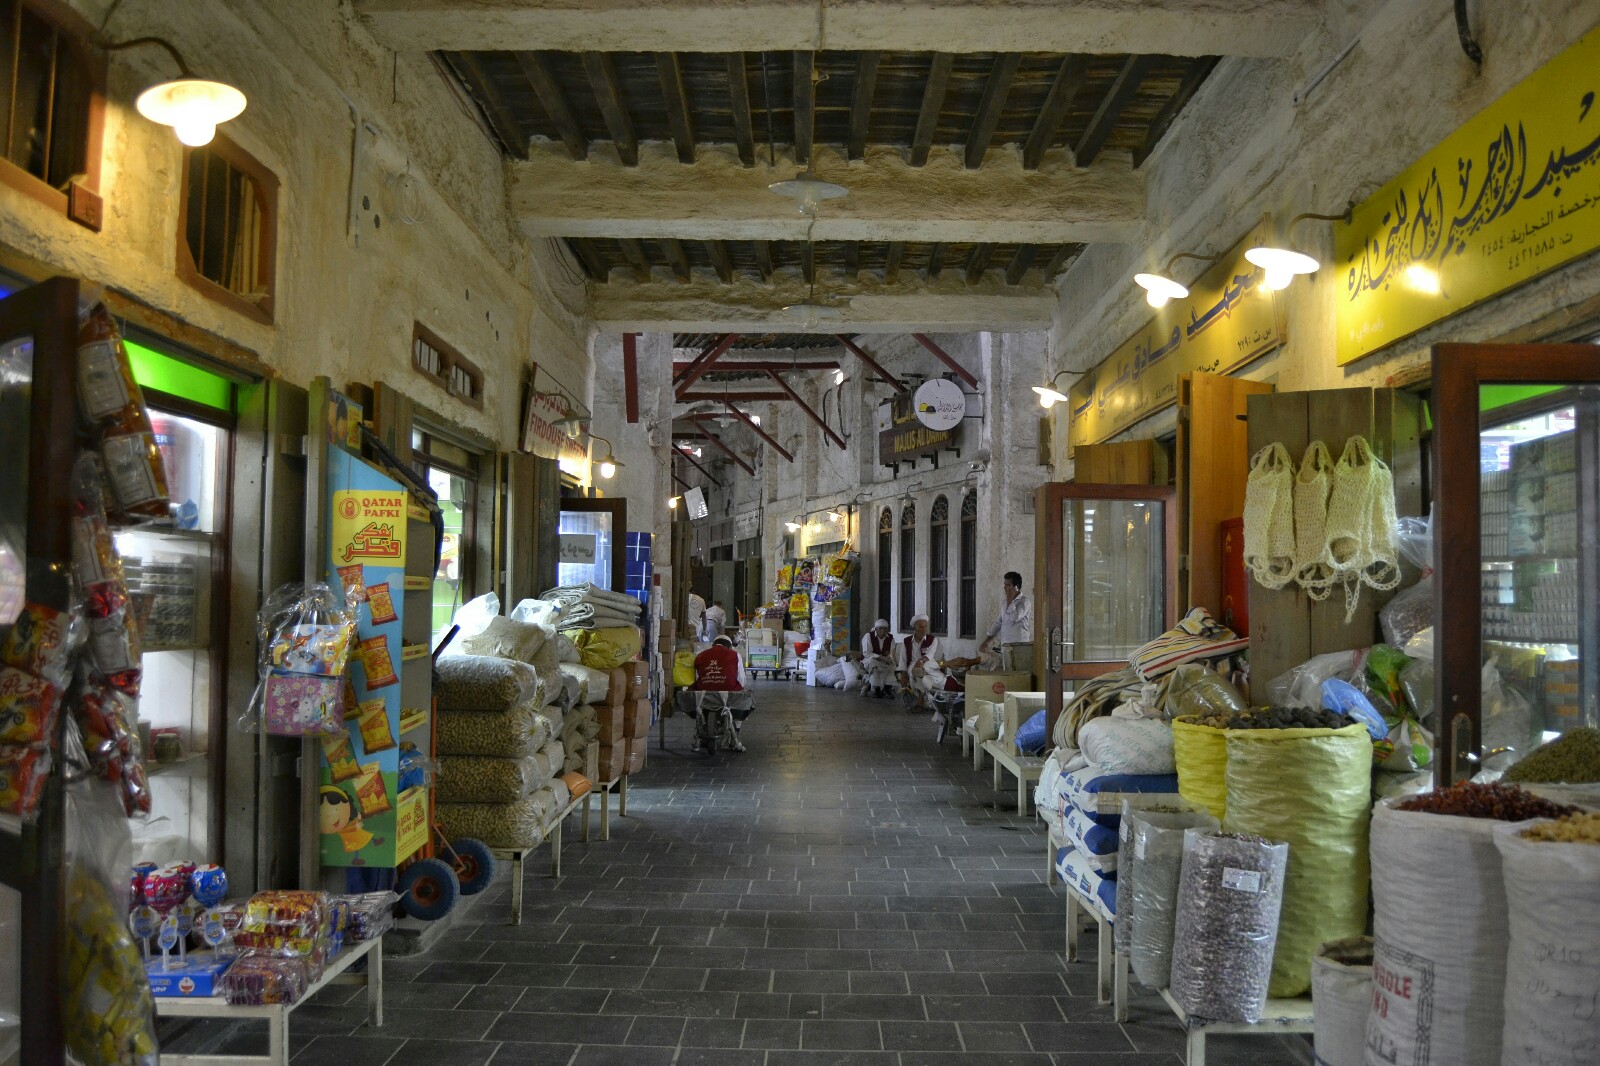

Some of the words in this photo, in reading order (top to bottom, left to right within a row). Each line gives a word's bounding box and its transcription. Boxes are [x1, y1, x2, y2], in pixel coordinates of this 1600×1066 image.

[362, 497, 402, 508] QATAR
[363, 509, 400, 518] PAFKI
[342, 537, 401, 562] قطر
